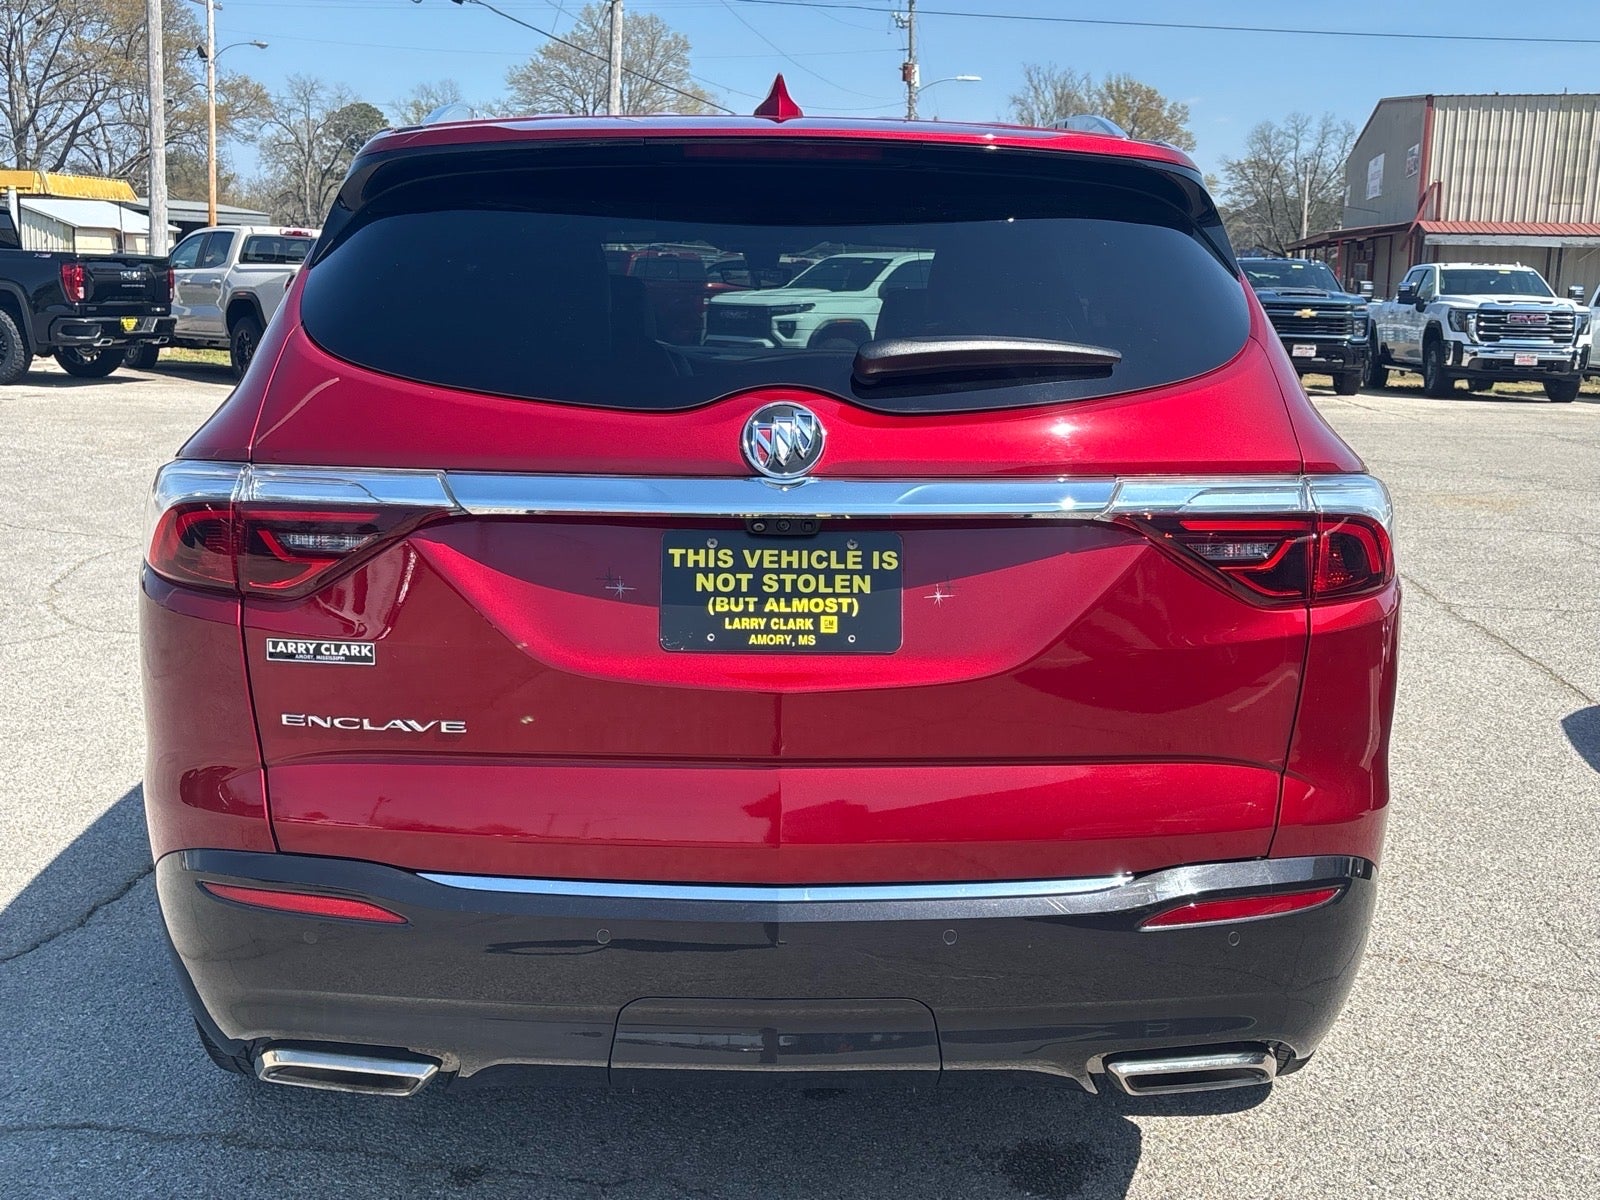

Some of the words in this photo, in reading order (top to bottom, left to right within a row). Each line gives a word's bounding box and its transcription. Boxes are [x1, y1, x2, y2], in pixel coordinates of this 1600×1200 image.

[1510, 315, 1546, 324] GMC
[668, 548, 734, 568] THIS
[743, 550, 863, 570] VEHICLE
[872, 551, 899, 570] IS
[695, 573, 754, 592] NOT
[762, 574, 871, 594] STOLEN
[707, 597, 758, 615] (BUT
[764, 597, 859, 617] ALMOST)
[724, 618, 765, 630] LARRY
[770, 618, 814, 630] CLARK
[268, 641, 317, 654] LARRY
[320, 643, 373, 657] CLARK
[748, 634, 796, 647] AMORY,
[798, 635, 816, 645] MS
[281, 713, 467, 734] ENCLAVE
